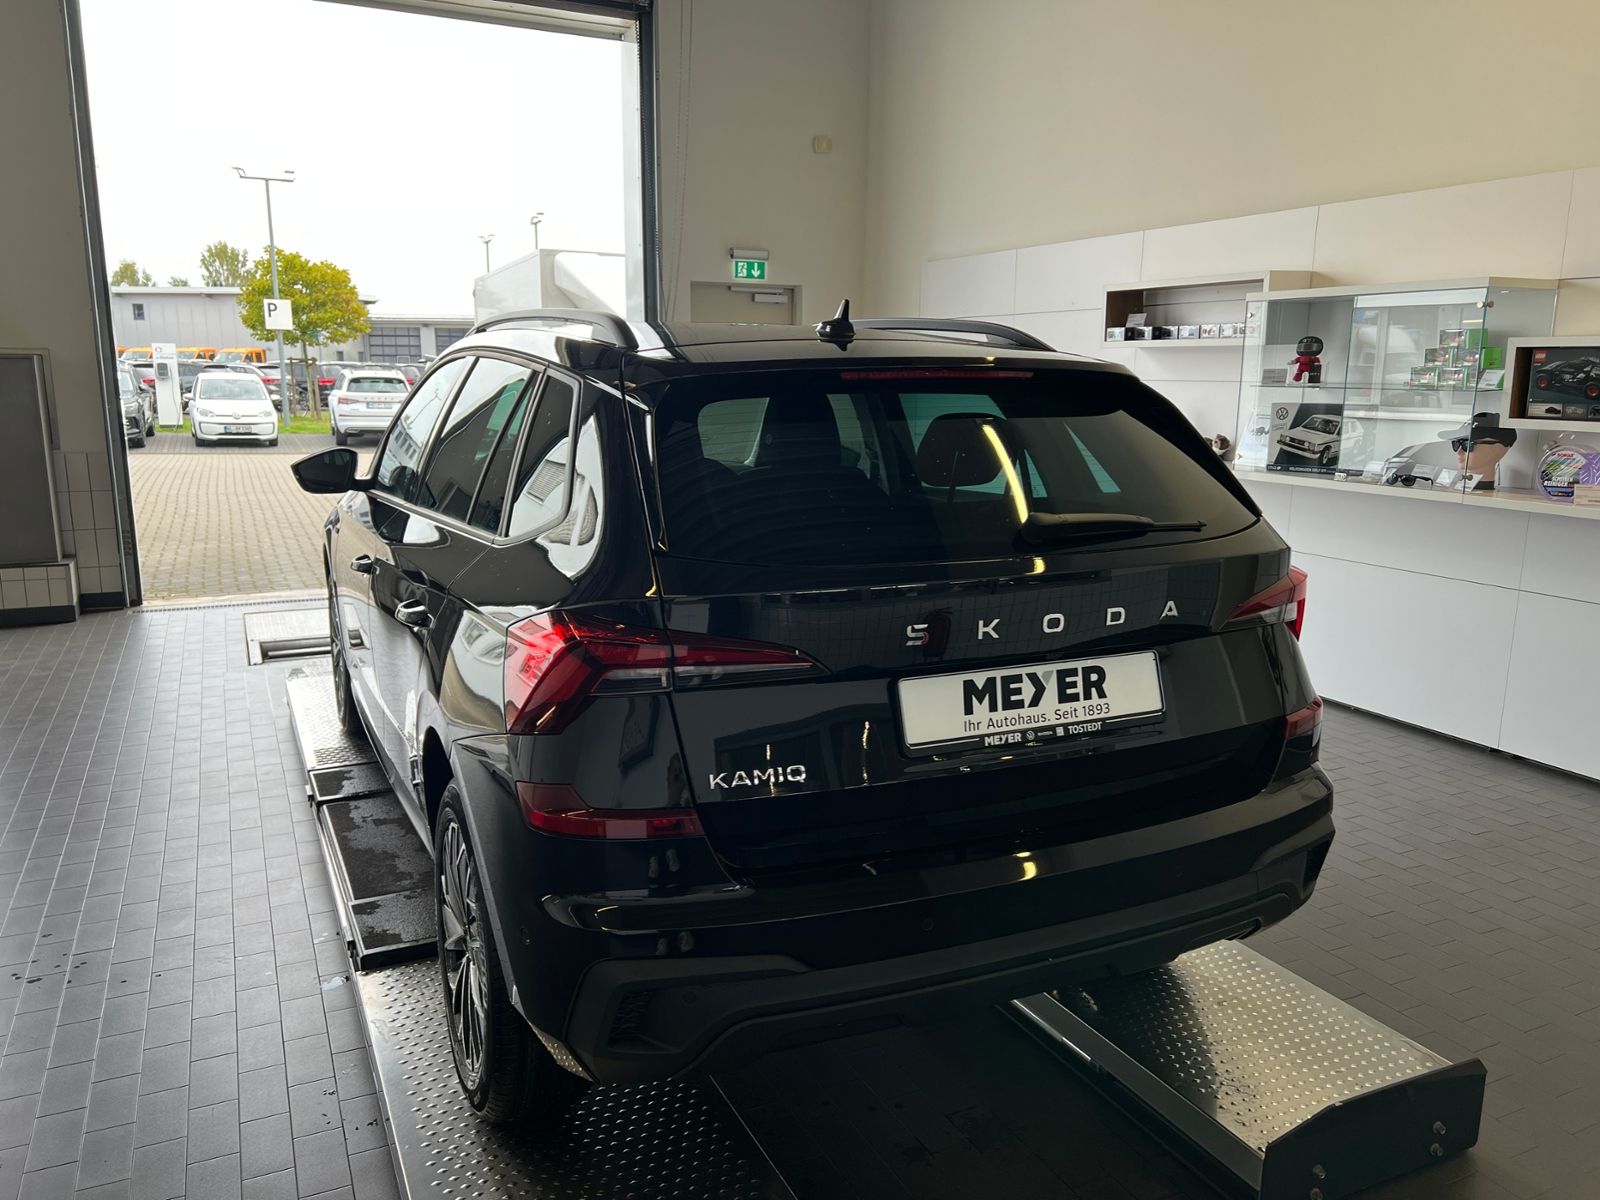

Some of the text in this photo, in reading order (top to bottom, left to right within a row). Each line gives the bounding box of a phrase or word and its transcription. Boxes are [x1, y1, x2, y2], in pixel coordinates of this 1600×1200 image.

[267, 302, 278, 318] P
[905, 600, 1179, 646] SKODA
[962, 664, 1109, 716] MEYER
[964, 702, 1111, 733] Ihr Autohaus. Seit 1893
[984, 732, 1022, 747] MEYER
[1067, 721, 1103, 735] TOSTEDT
[709, 765, 807, 790] KAMIQ
